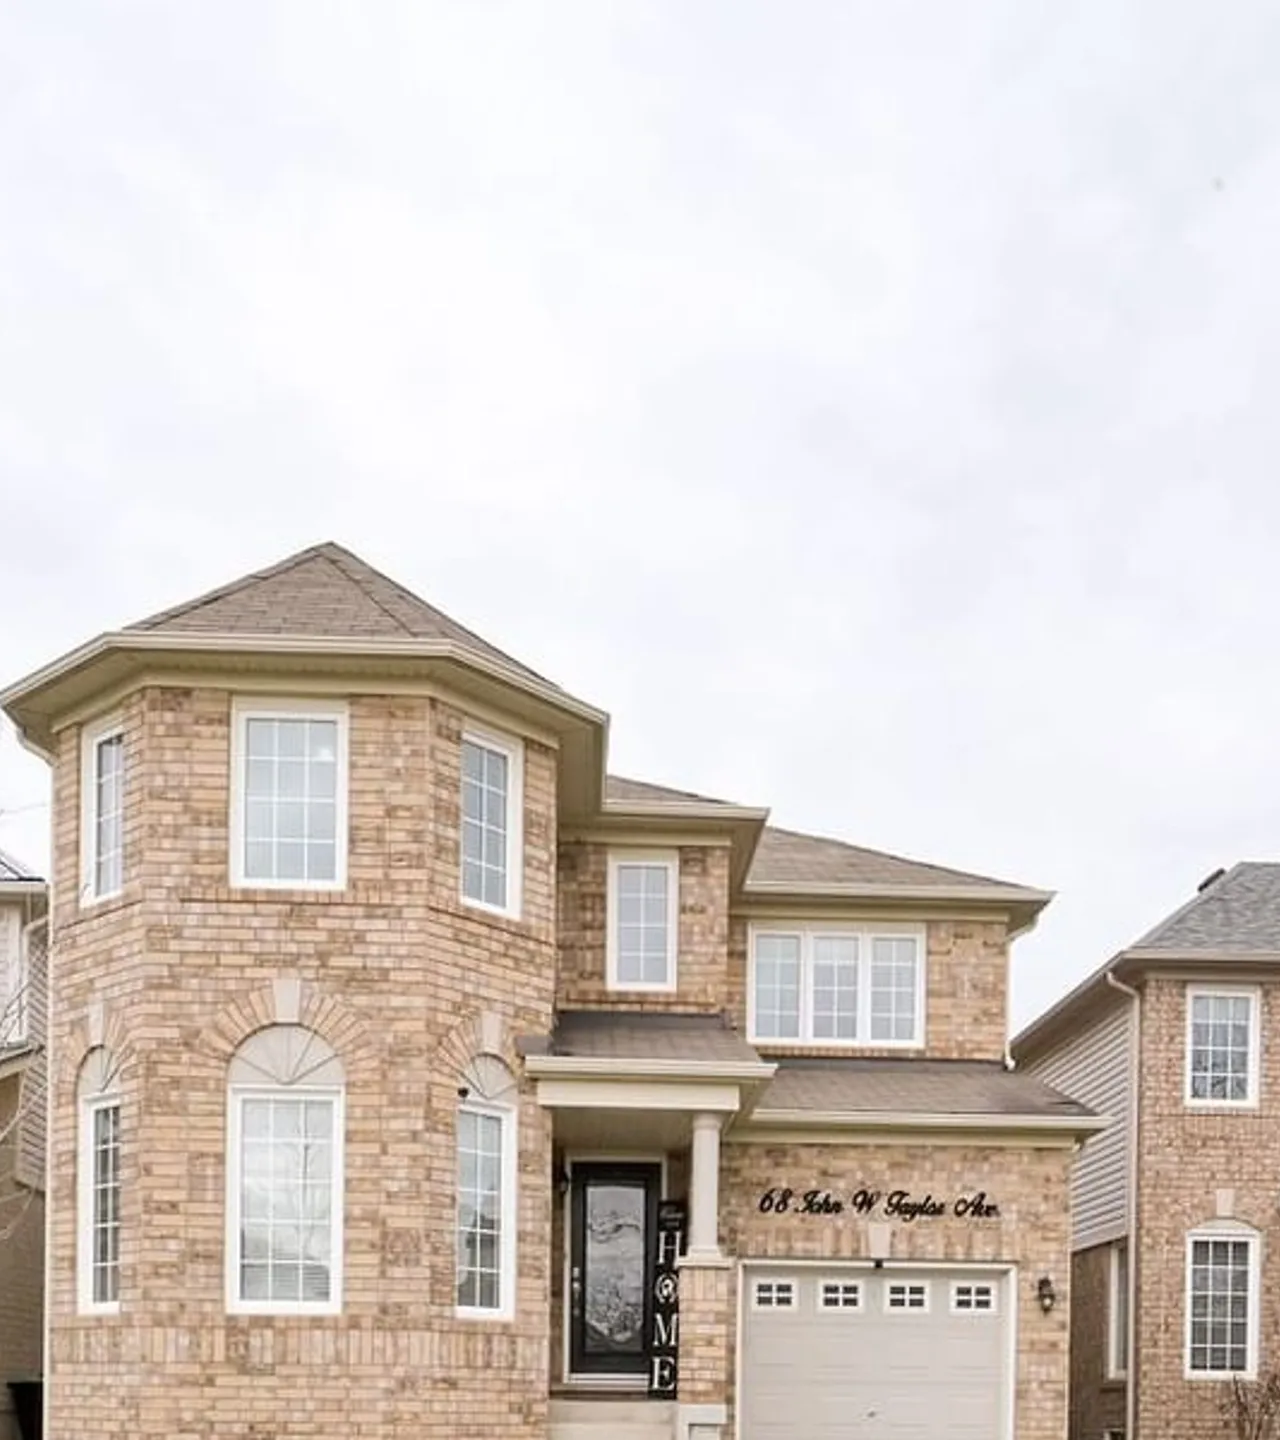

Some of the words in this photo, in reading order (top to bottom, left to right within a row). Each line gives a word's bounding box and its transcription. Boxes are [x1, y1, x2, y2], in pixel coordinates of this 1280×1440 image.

[759, 1187, 793, 1213] 68
[794, 1190, 844, 1214] John
[852, 1189, 881, 1214] W
[884, 1190, 945, 1222] Taylor
